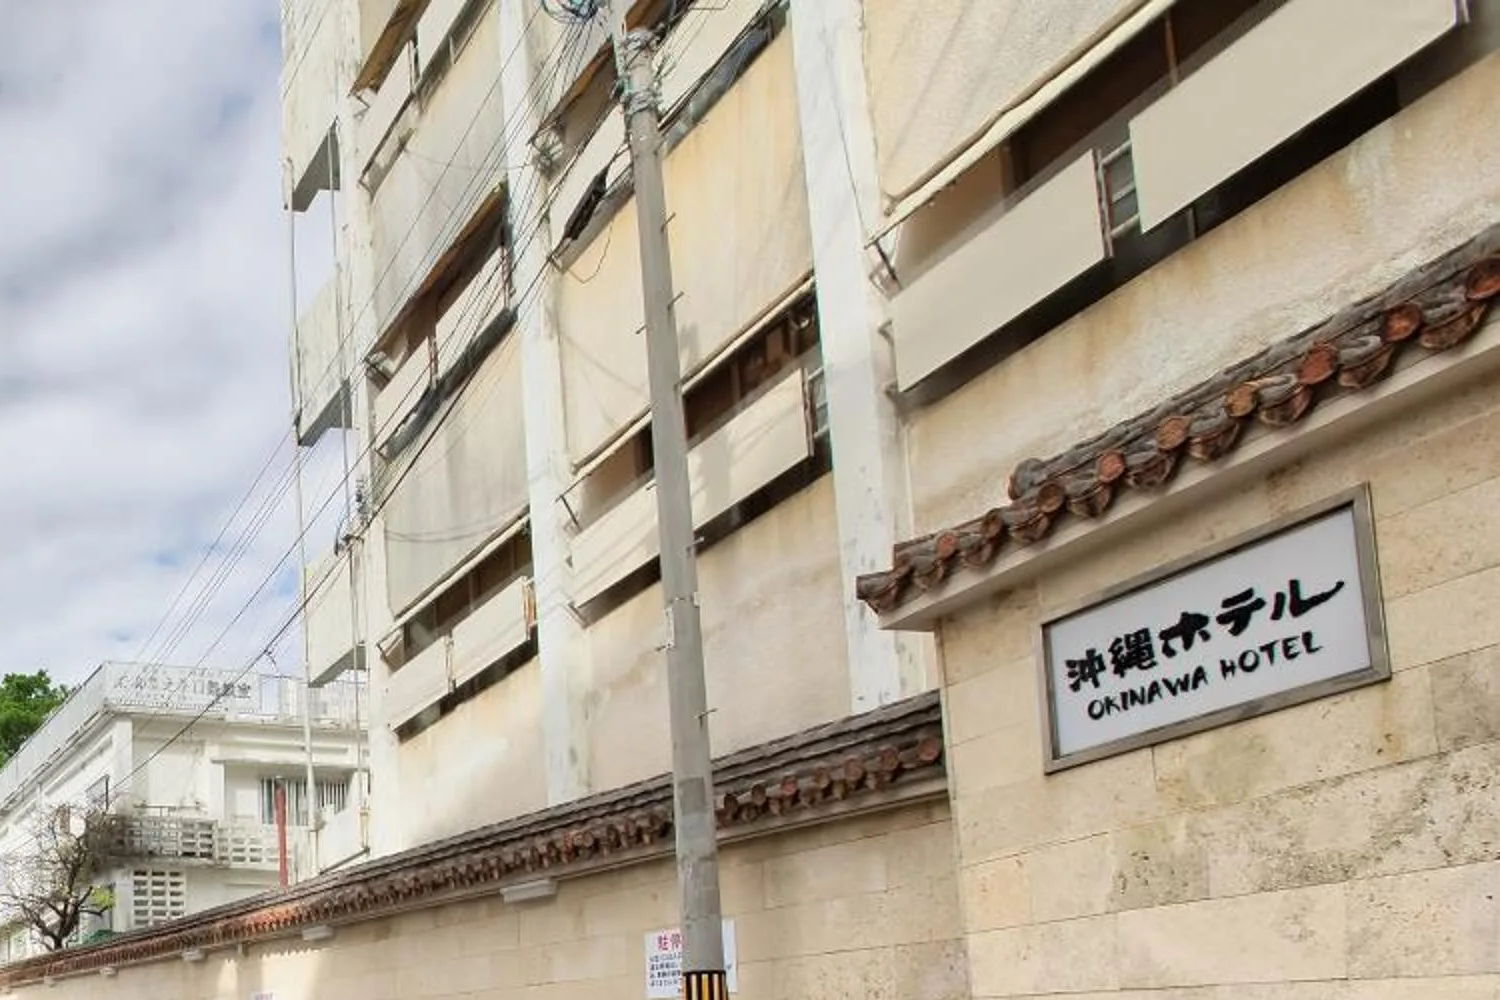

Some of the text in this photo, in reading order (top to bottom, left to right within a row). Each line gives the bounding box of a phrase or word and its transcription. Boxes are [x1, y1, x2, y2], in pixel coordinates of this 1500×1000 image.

[1065, 579, 1345, 693] 沖縄ホテル
[1087, 630, 1324, 721] OKINAWA HOTEL
